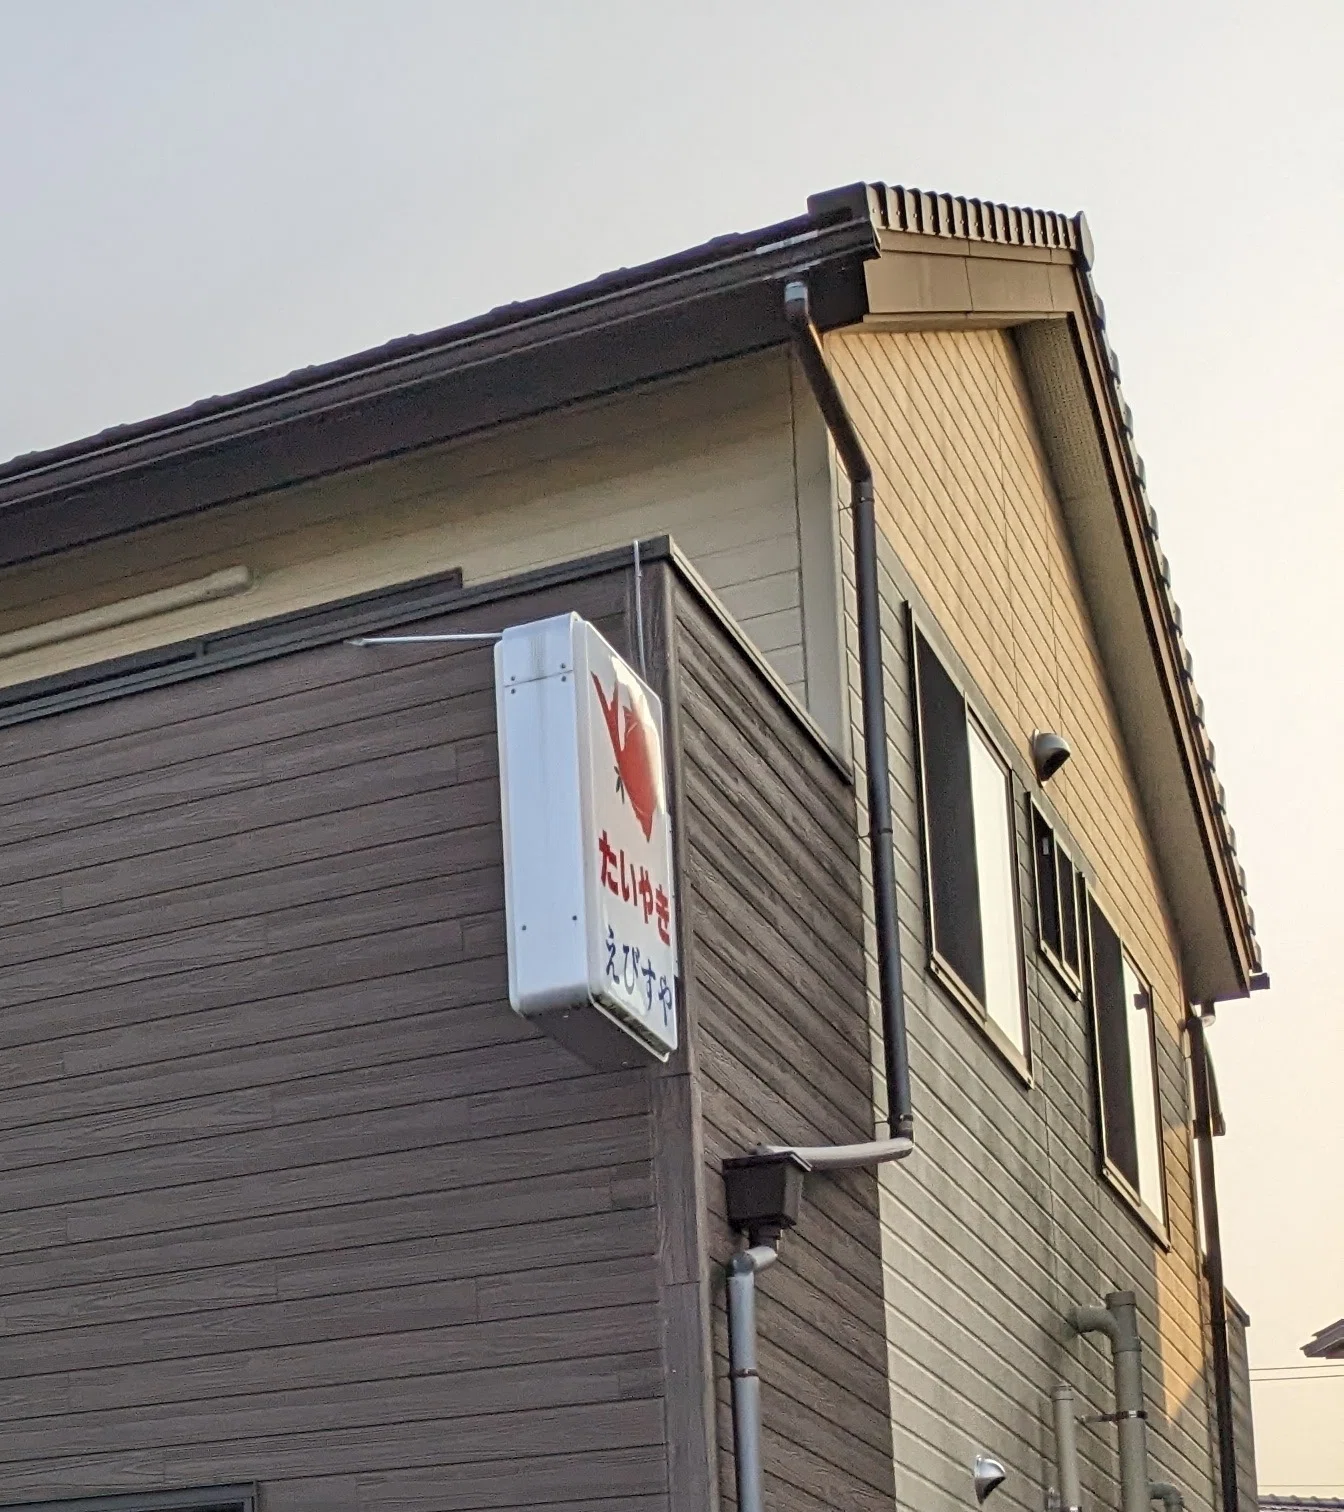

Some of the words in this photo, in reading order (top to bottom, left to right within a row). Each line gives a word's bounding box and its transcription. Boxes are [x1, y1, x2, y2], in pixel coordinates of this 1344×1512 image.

[597, 830, 671, 946] たいやき
[604, 924, 673, 1026] えびすや
